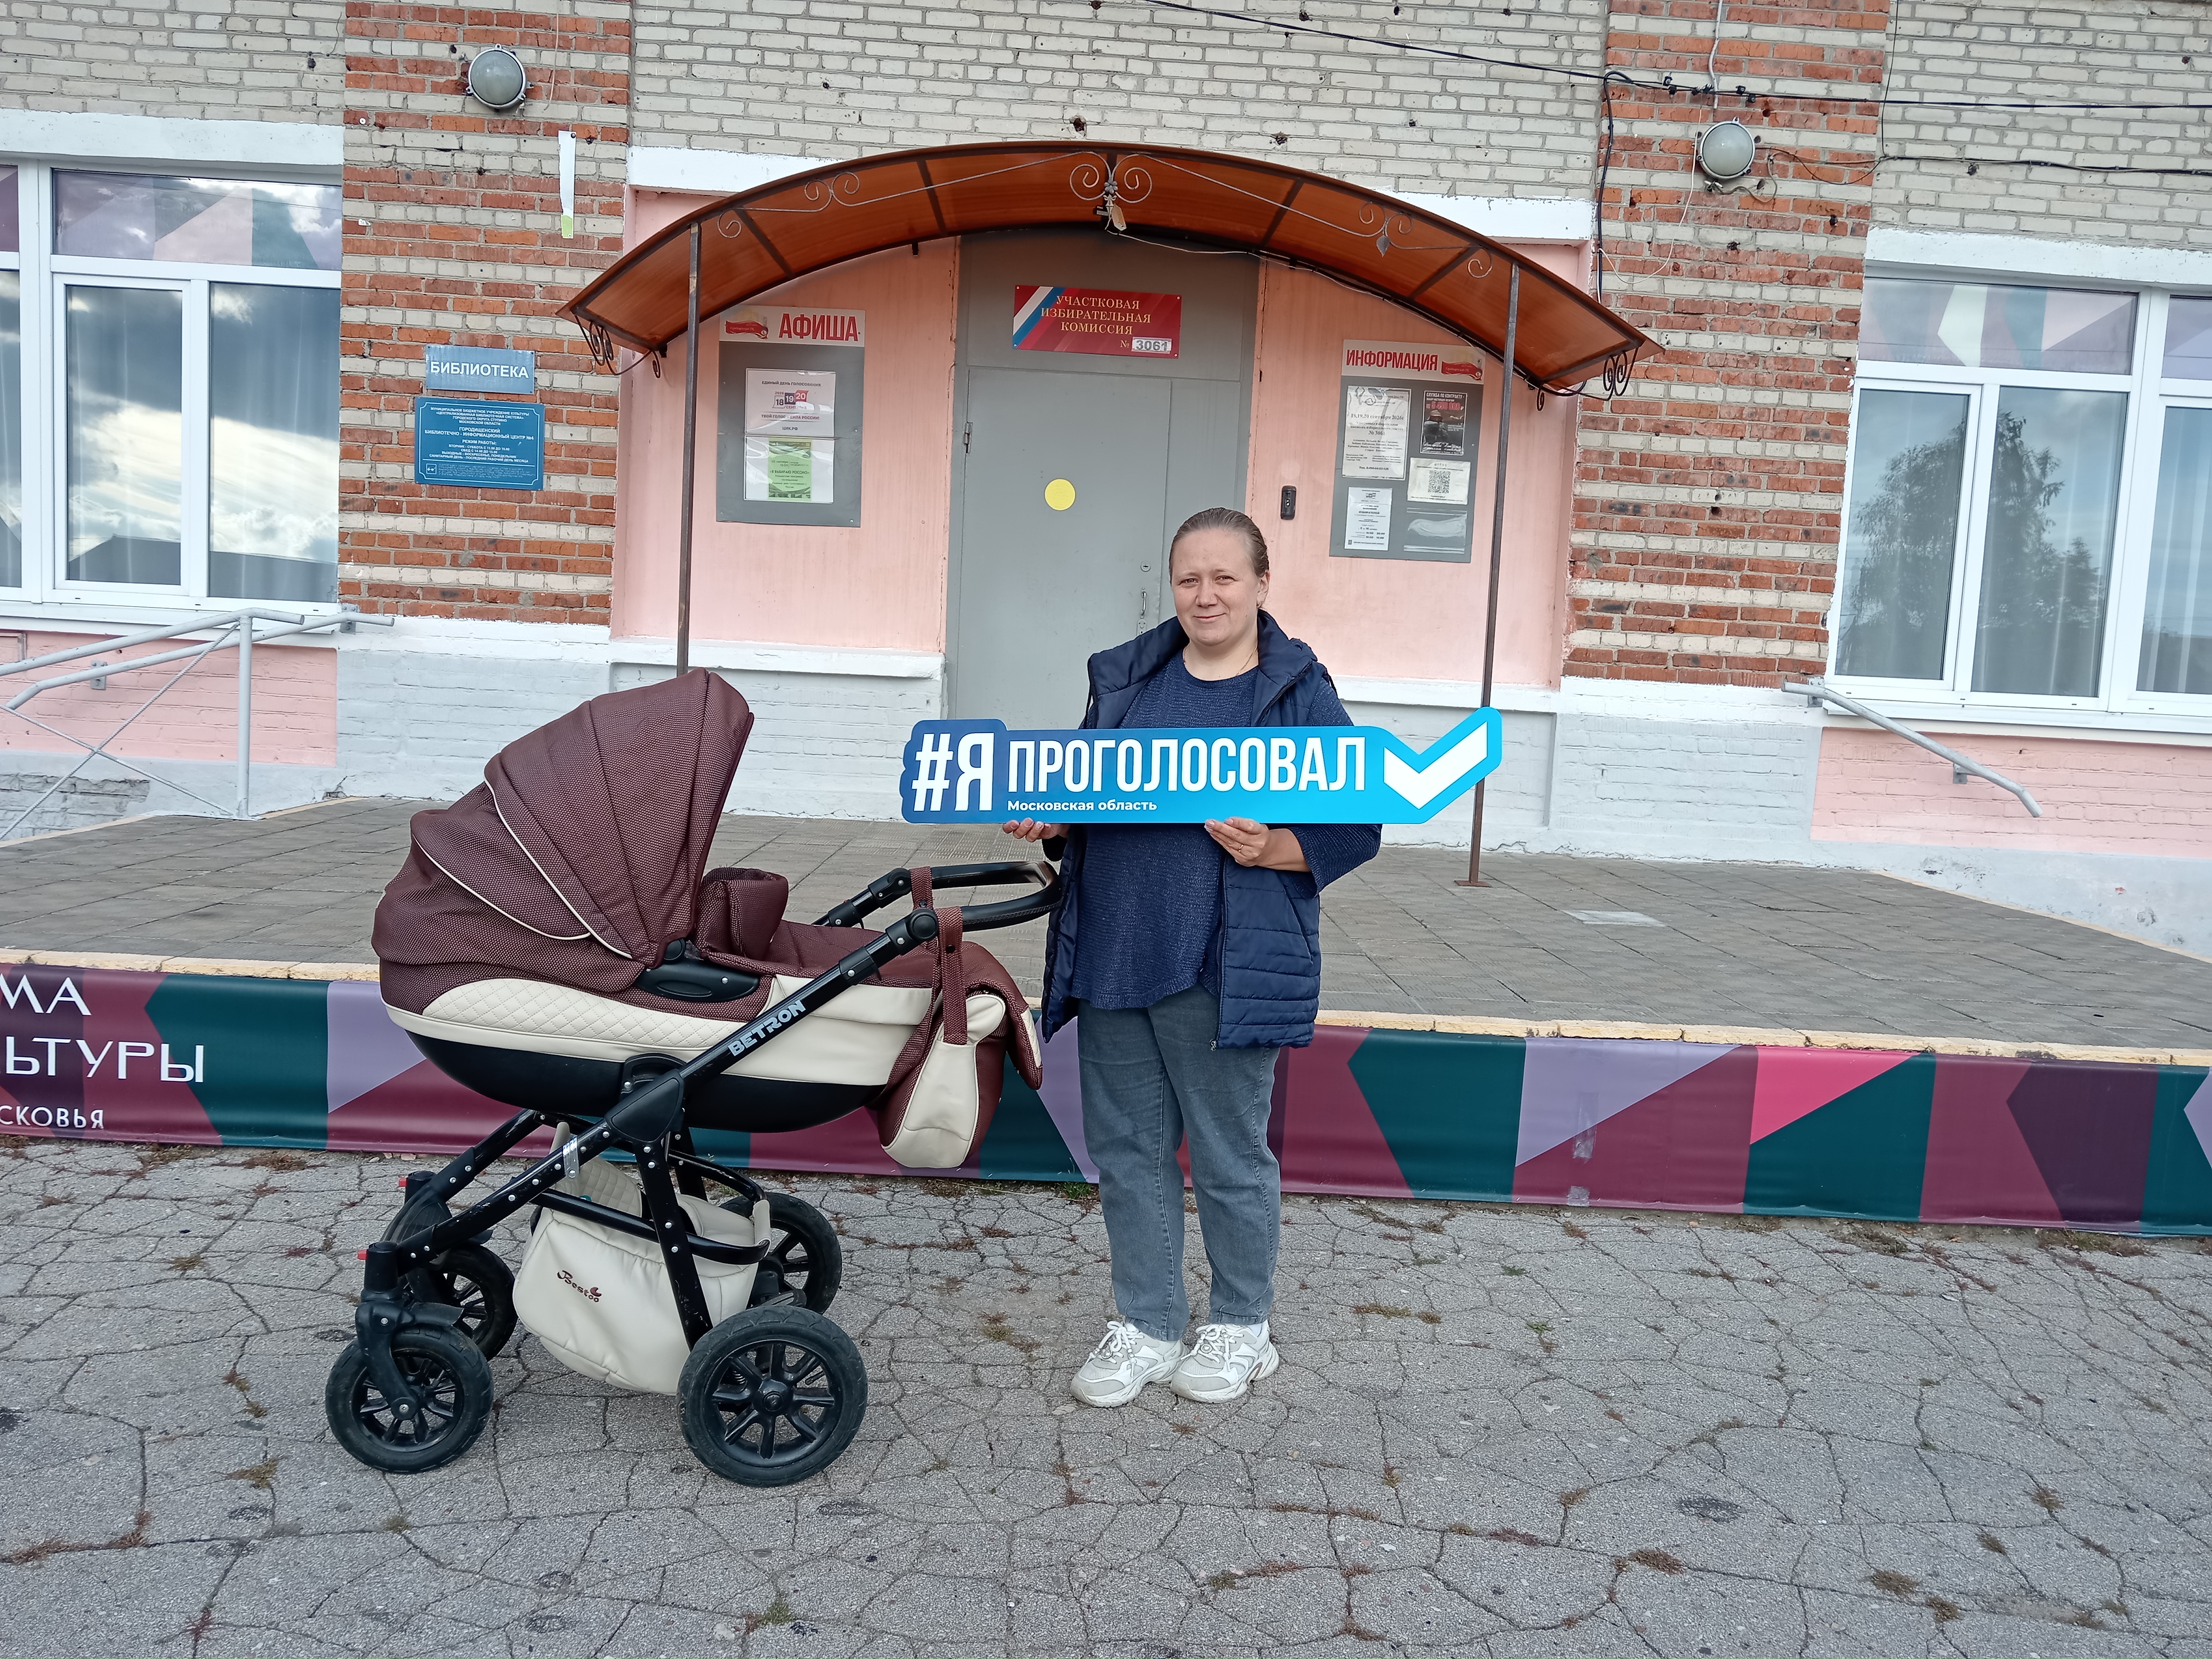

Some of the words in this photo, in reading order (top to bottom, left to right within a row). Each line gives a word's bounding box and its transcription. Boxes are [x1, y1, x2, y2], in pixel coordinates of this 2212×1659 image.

[1056, 296, 1140, 310] УЧАСТКОВАЯ
[1041, 308, 1151, 323] ИЗБИРАТЕЛЬНАЯ
[779, 313, 858, 341] АФИША
[1061, 322, 1133, 335] КОМИССИЯ
[1120, 340, 1130, 348] №
[1135, 340, 1168, 352] 3061
[430, 361, 529, 378] БИБЛИОТЕКА
[1346, 349, 1438, 371] ИНФОРМАЦИЯ
[912, 732, 994, 811] #Я
[1008, 737, 1365, 792] ПРОГОЛОСОВАЛ
[1007, 800, 1094, 811] Московская
[1098, 799, 1157, 811] область
[0, 973, 92, 1016] МА
[728, 1000, 806, 1056] BETRON
[6, 1036, 204, 1083] ЬТУРЫ
[0, 1105, 104, 1129] СКОВЬЯ
